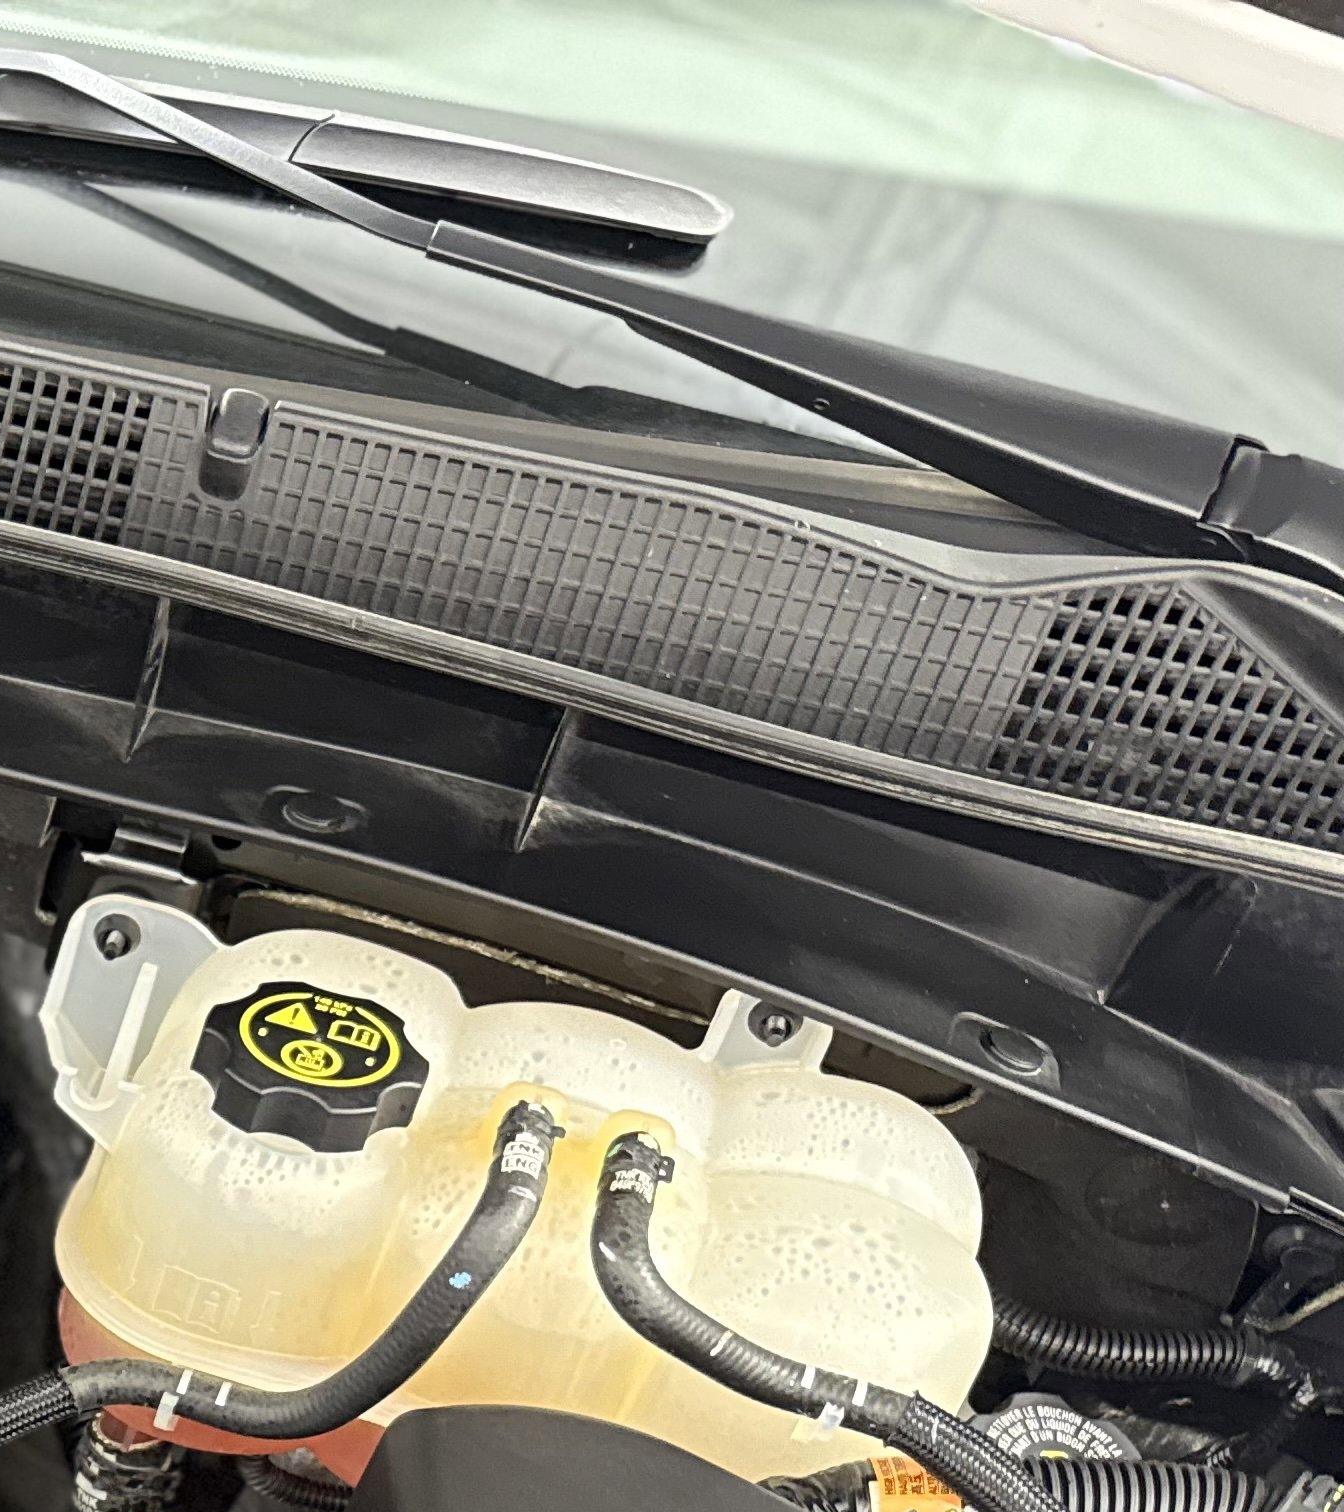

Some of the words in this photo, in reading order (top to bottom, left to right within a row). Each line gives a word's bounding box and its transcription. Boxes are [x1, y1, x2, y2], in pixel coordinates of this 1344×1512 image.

[1022, 1405, 1035, 1419] LE
[1036, 1405, 1082, 1427] BOUCHON
[1082, 1420, 1113, 1444] AVANT
